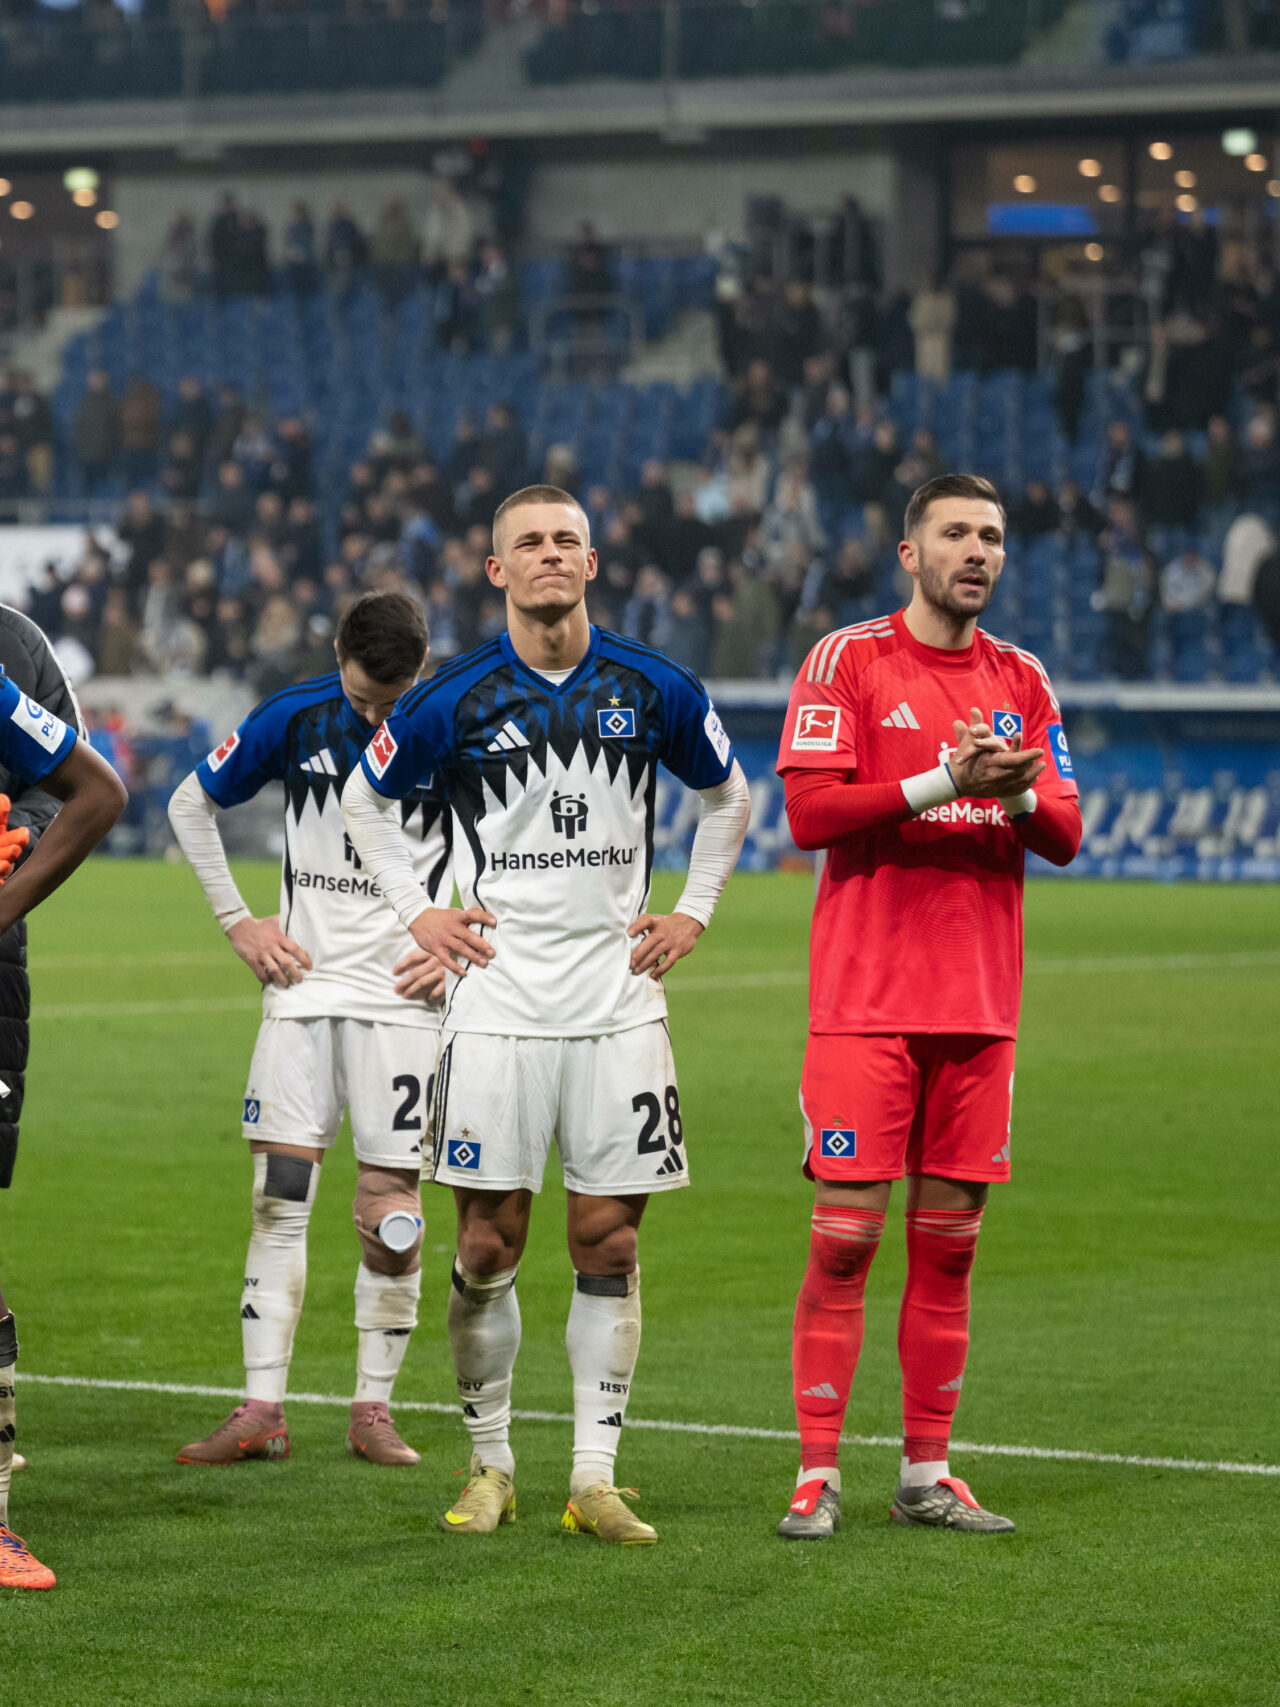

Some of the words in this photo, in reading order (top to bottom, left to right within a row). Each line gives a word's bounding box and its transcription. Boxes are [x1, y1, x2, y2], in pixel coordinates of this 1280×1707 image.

[392, 1074, 435, 1131] 2
[632, 1085, 683, 1155] 28
[599, 1381, 629, 1394] HSV
